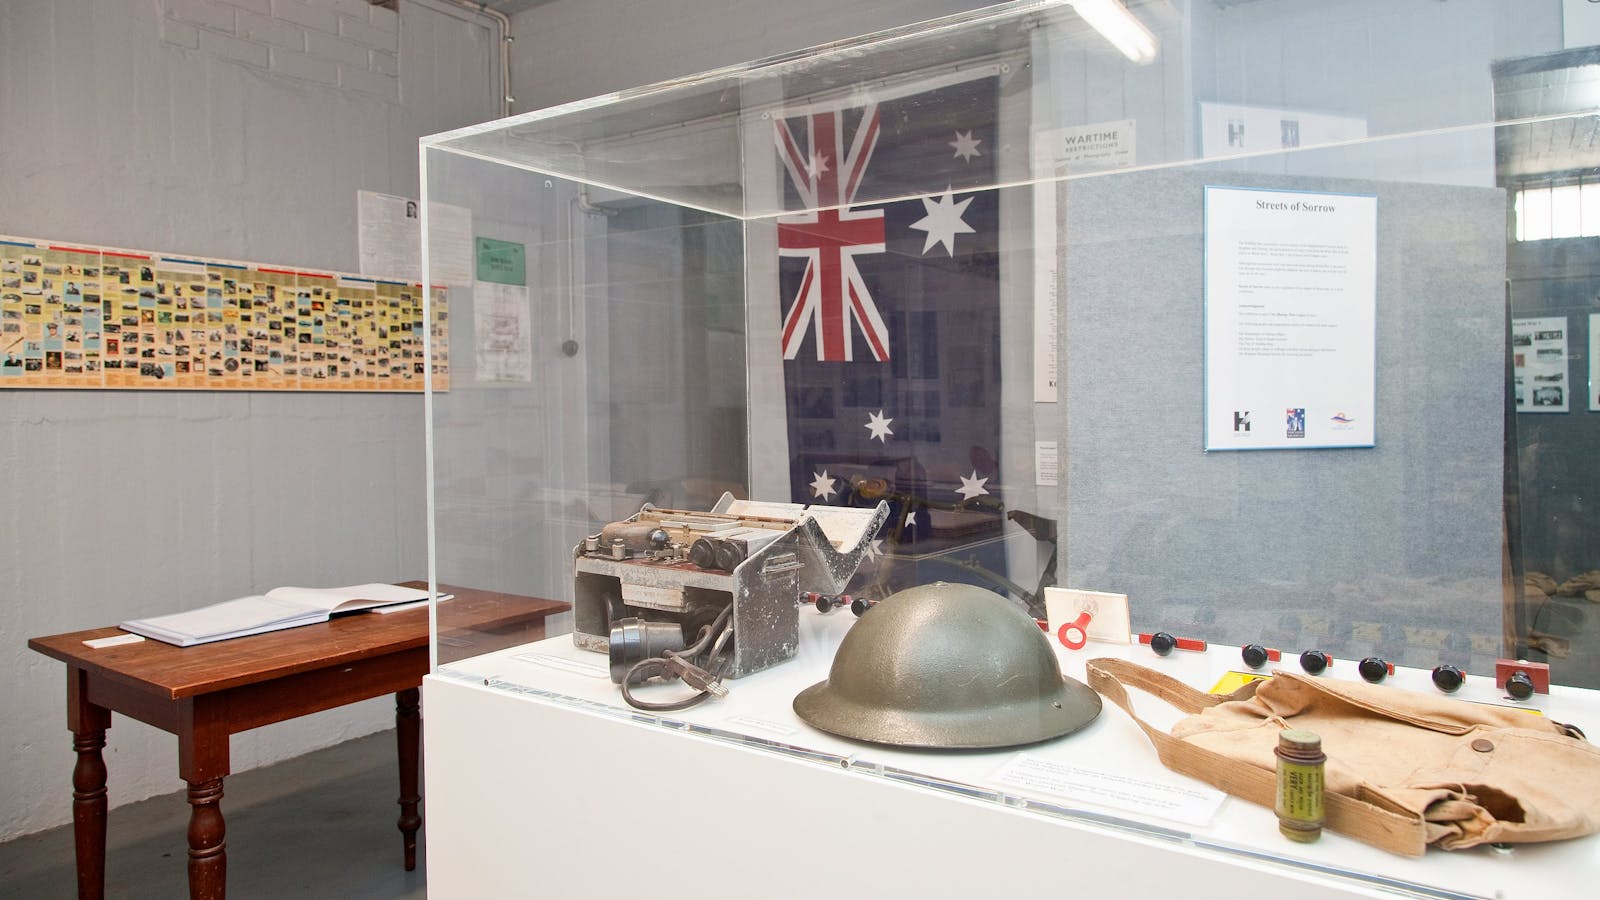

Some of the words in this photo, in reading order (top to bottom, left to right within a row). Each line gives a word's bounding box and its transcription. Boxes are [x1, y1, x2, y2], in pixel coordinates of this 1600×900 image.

[1065, 131, 1118, 145] WARTIME
[1065, 142, 1118, 153] RESTRICTIONS
[1256, 199, 1288, 211] Streets
[1291, 201, 1300, 212] of
[1302, 202, 1336, 213] Sorrow
